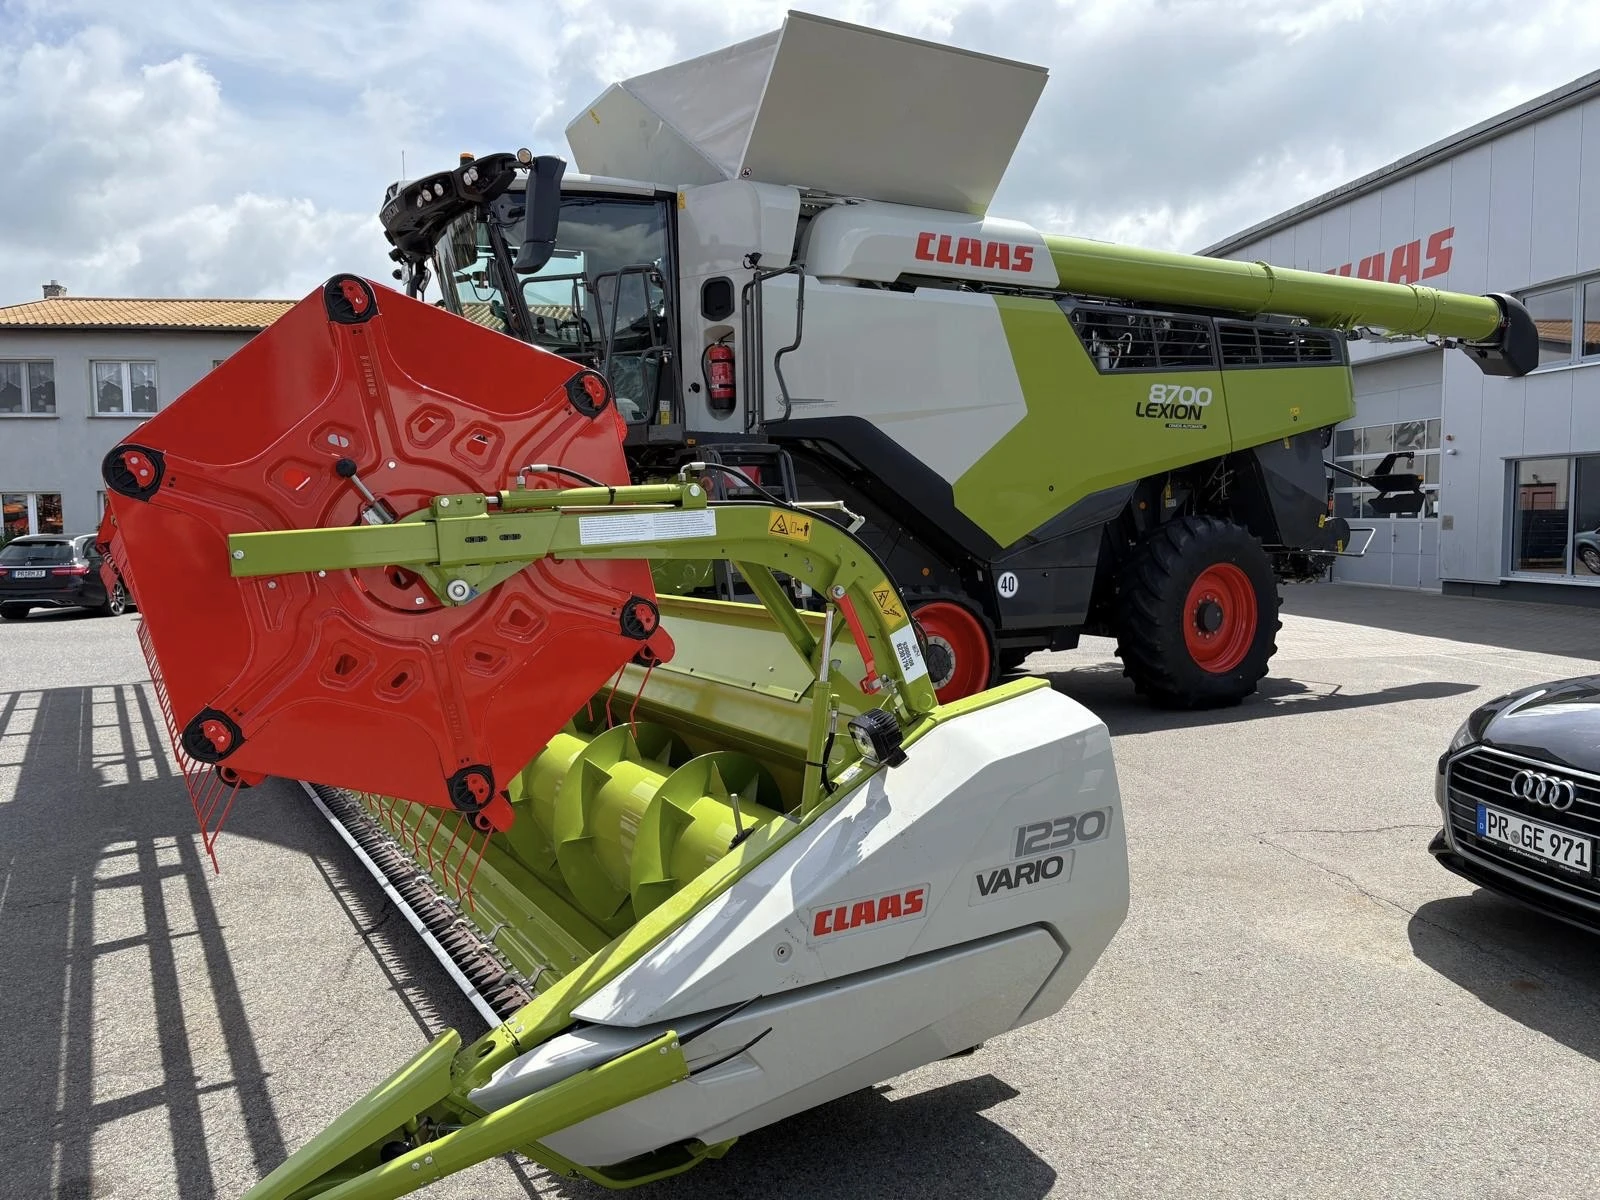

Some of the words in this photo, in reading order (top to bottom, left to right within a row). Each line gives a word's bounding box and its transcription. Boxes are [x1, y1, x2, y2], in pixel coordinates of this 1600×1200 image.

[914, 231, 1034, 273] CLAAS
[1322, 226, 1455, 285] AAS
[1135, 401, 1203, 421] LEXION
[1148, 383, 1213, 407] 8700
[1001, 576, 1015, 592] 40
[1014, 810, 1107, 858] 1230
[1487, 811, 1509, 841] PR
[1521, 824, 1544, 854] GE
[1549, 833, 1587, 867] 971
[975, 855, 1064, 898] VARIO
[813, 888, 924, 938] CLAAS
